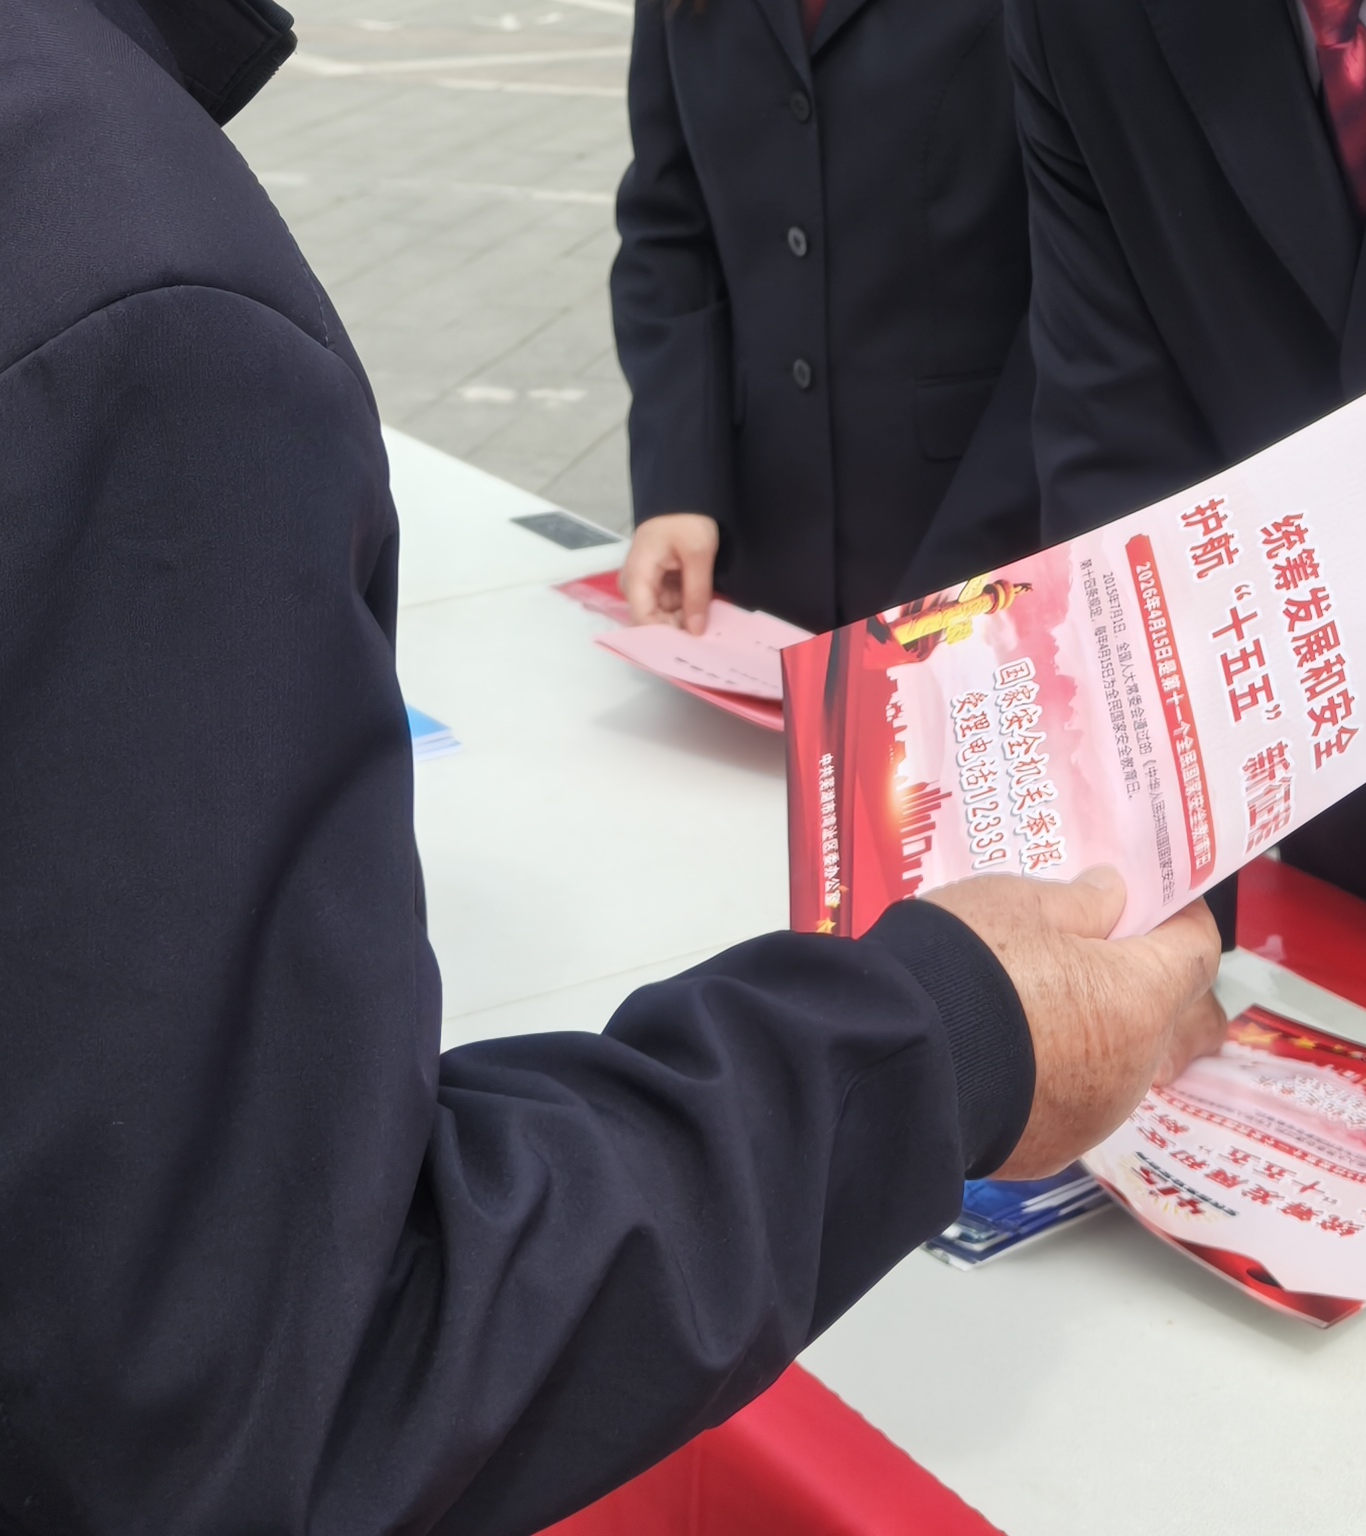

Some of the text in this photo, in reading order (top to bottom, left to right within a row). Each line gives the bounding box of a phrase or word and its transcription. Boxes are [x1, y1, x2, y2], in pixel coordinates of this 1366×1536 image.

[1261, 513, 1359, 769] 统筹发展和安全
[953, 691, 1008, 868] 受理电话12339
[996, 659, 1064, 873] 国家安全机关举报
